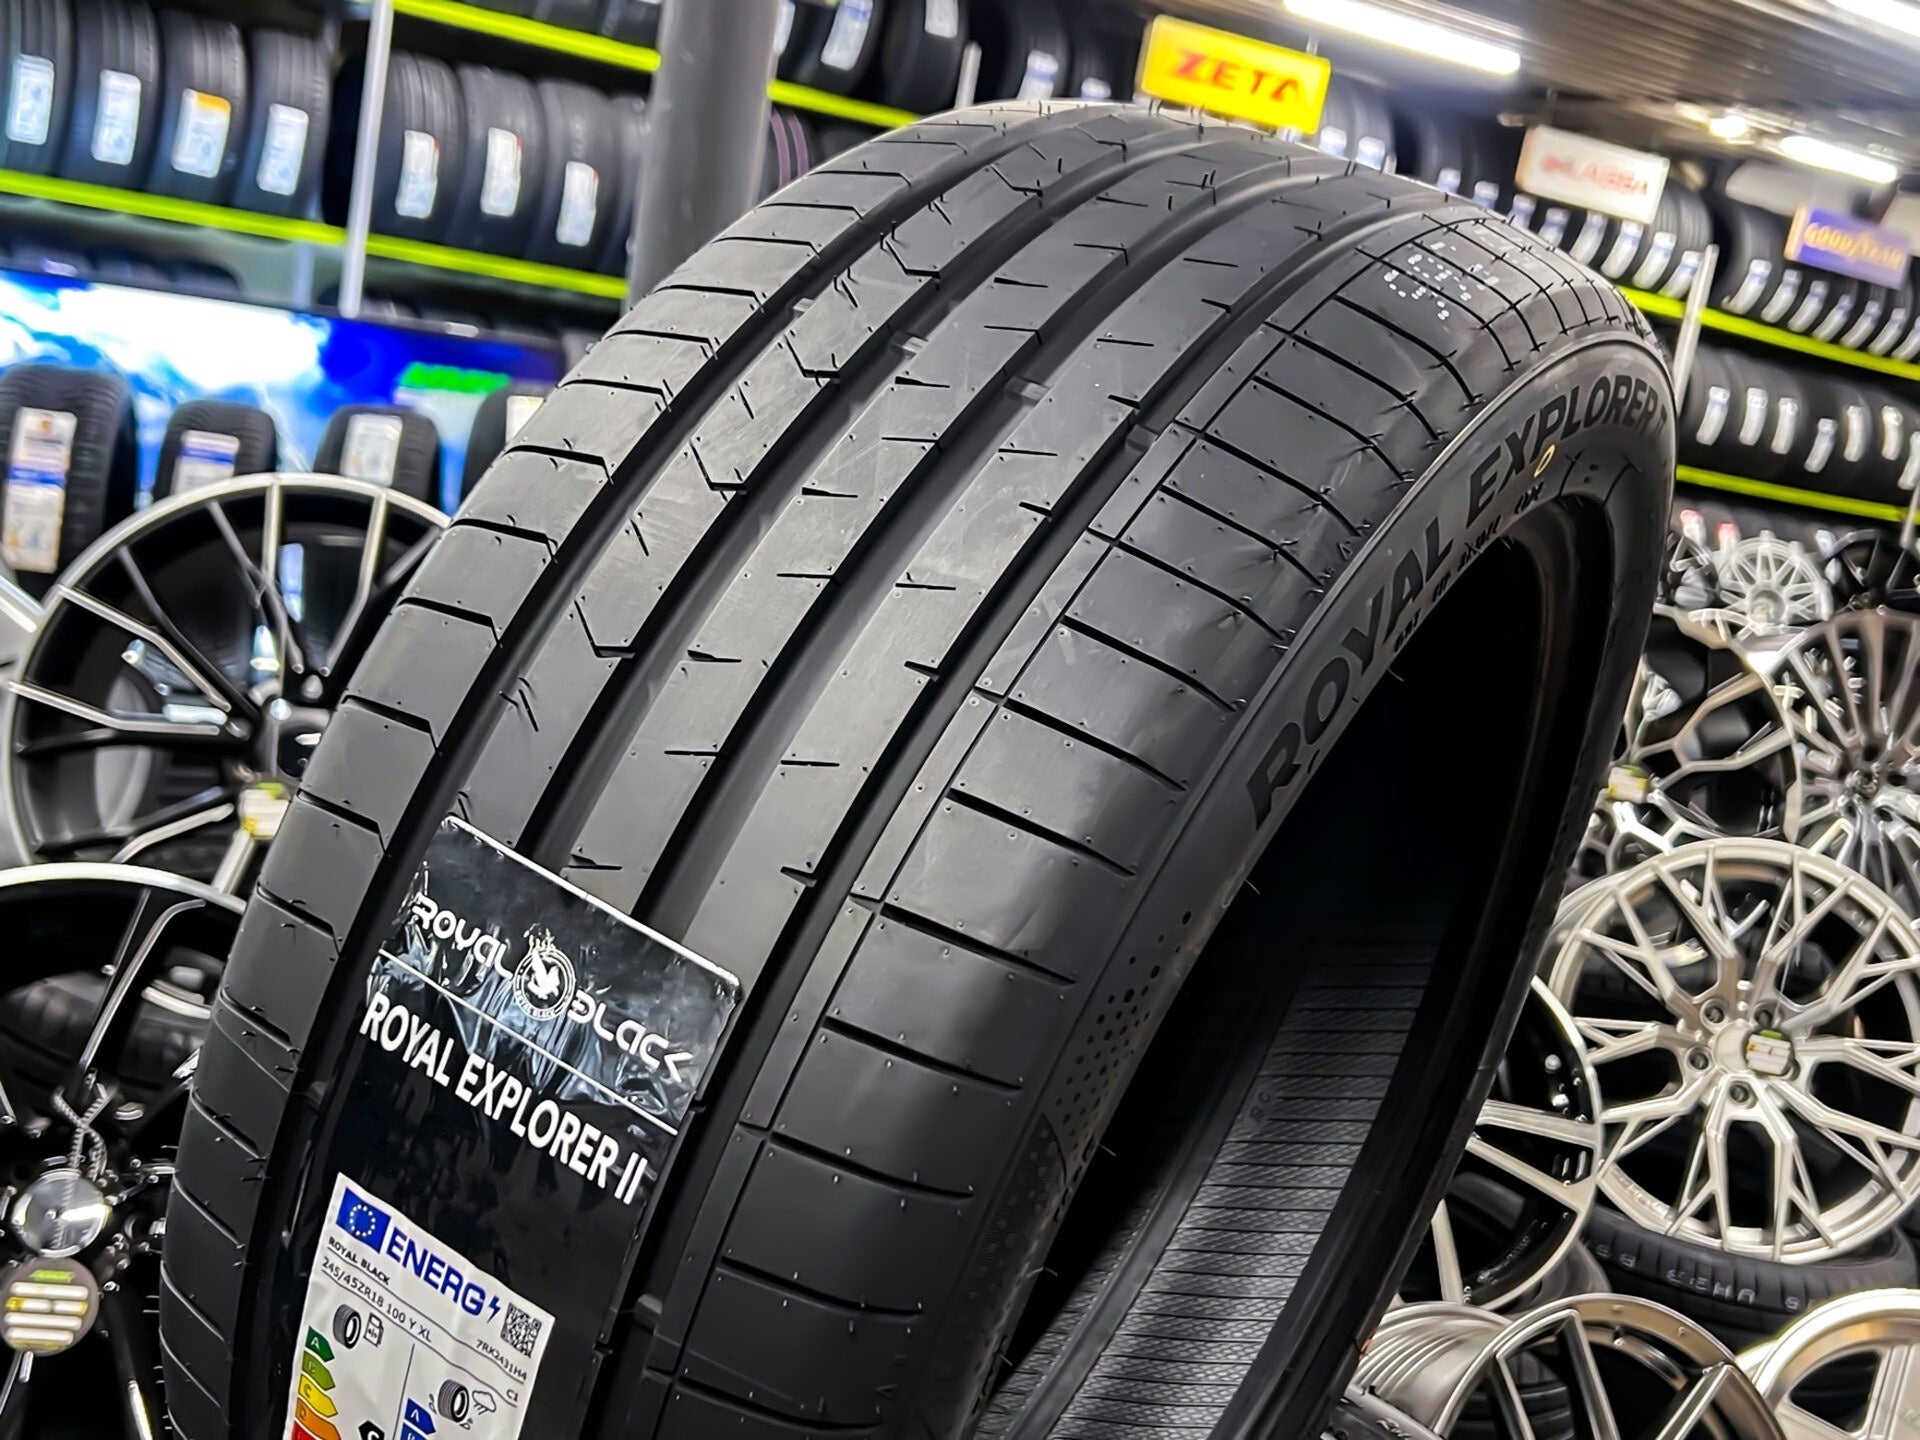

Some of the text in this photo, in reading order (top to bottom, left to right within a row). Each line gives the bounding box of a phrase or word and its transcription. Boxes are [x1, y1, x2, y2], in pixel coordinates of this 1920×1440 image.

[1169, 50, 1300, 103] ZETA
[1247, 516, 1453, 831] ROYAL
[1466, 374, 1659, 529] EXPLORER
[411, 890, 694, 1084] ROYAL BLACK
[360, 990, 648, 1206] ROYAL EXPLORER II
[321, 1256, 432, 1343] 245/45ZR18 100 Y XL
[327, 1235, 391, 1286] ROYAL BLACK
[386, 1226, 487, 1317] ENERG
[310, 1336, 320, 1350] A
[506, 1388, 519, 1403] C1
